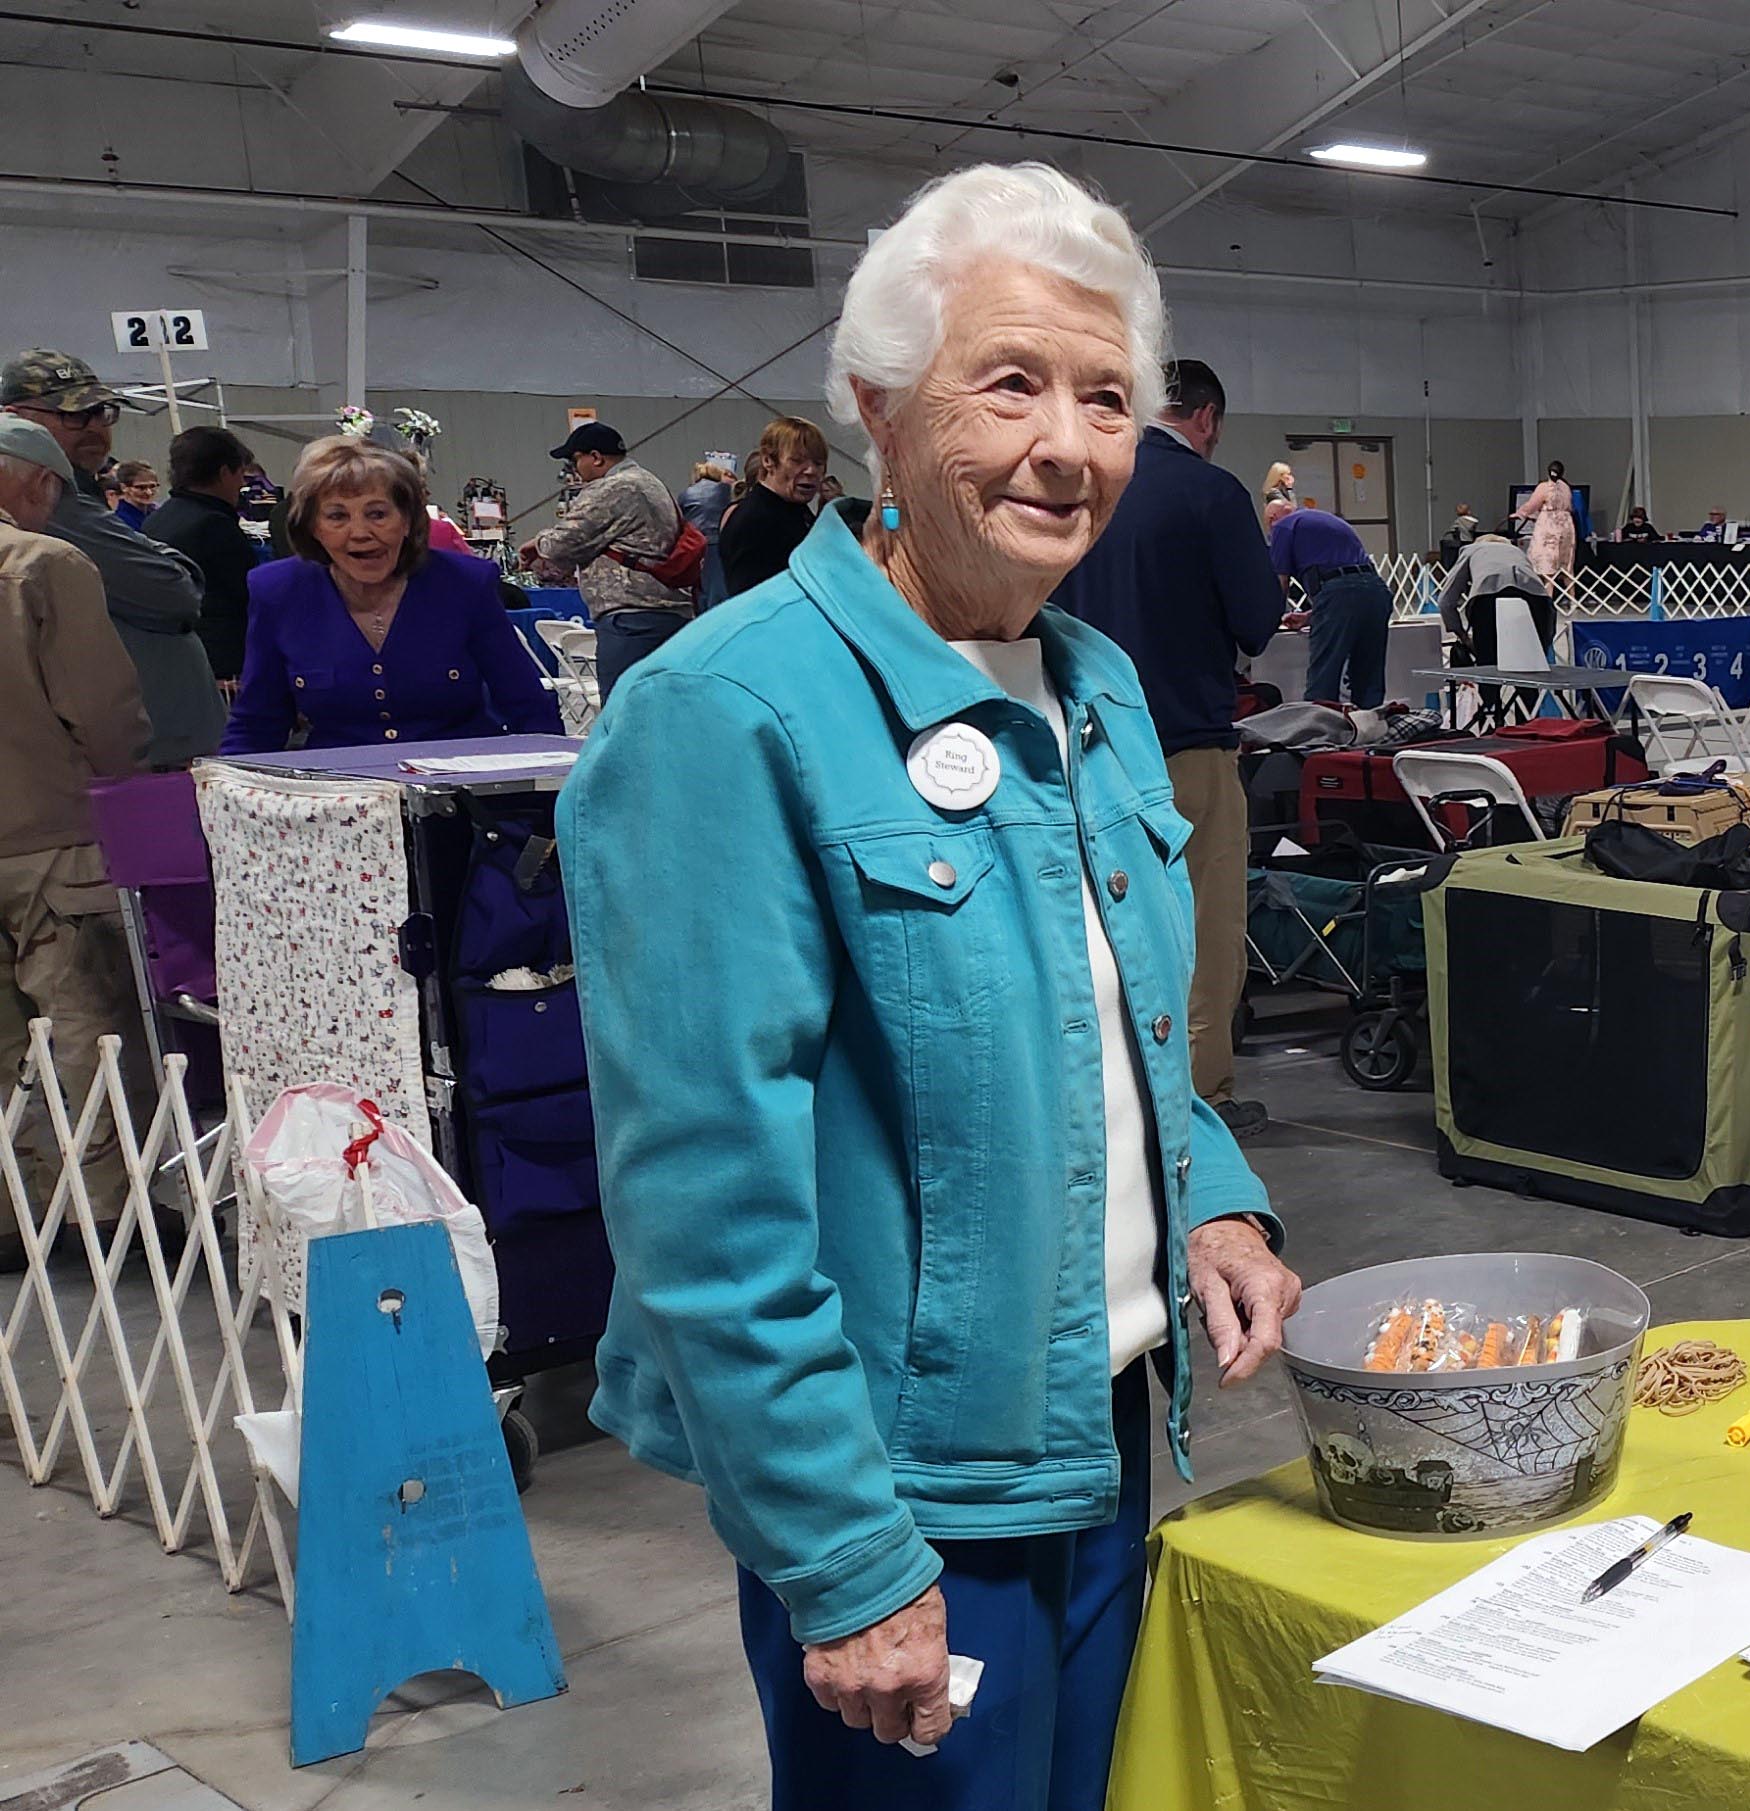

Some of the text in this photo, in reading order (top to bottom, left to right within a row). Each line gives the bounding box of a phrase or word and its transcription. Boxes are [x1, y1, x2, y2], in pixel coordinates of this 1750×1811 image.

[127, 316, 150, 347] 2
[173, 315, 195, 345] 2
[1615, 652, 1627, 672] 1
[1654, 653, 1669, 676] 2
[1693, 652, 1707, 681] 3
[1729, 651, 1744, 680] 4
[936, 761, 975, 774] Steward
[946, 750, 967, 762] Ring
